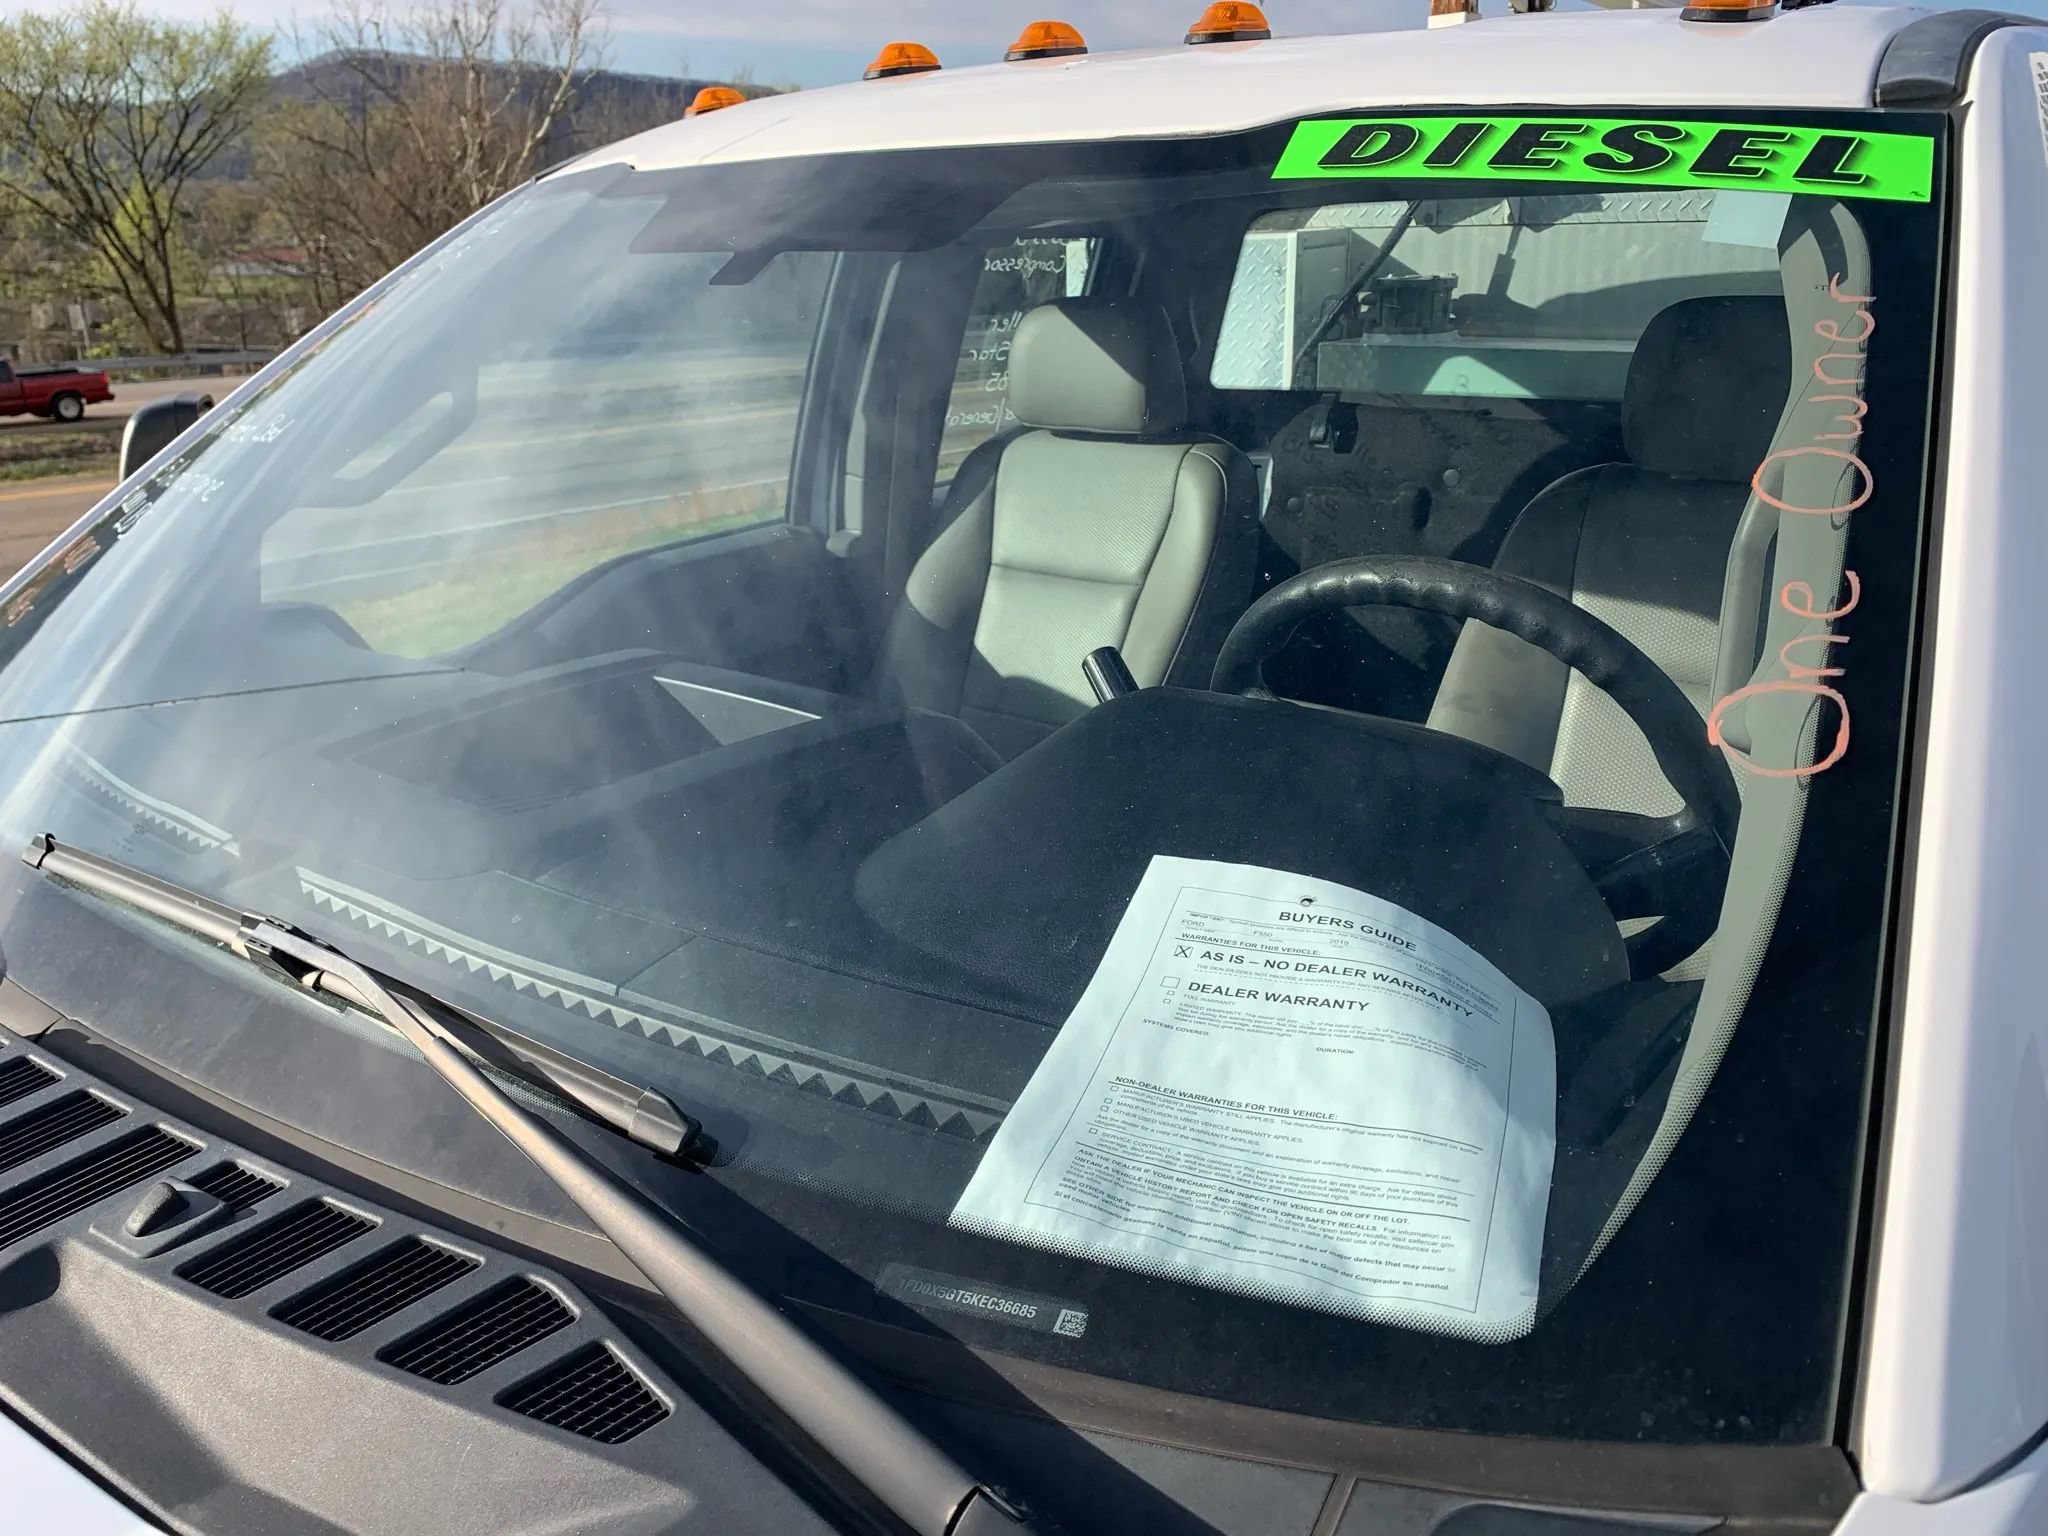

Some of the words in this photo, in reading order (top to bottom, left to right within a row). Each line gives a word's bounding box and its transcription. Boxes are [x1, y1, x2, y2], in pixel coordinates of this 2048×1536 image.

[1317, 122, 1870, 184] DIESEL
[1753, 272, 1876, 514] Owner
[1707, 570, 1861, 777] One
[1181, 919, 1205, 928] FORD
[1181, 932, 1237, 945] WARRANTIES
[1279, 911, 1355, 929] BUYERS
[1360, 924, 1417, 952] GUIDE
[1188, 981, 1260, 1000] DEALER
[1265, 991, 1371, 1011] WARRANTY
[1200, 950, 1224, 962] AS
[1229, 954, 1245, 965] IS
[1264, 959, 1290, 970] NO
[1294, 962, 1367, 979] DEALER
[1373, 972, 1473, 1017] WARRANTY
[1143, 1018, 1174, 1030] SYSTEMS
[1115, 1076, 1176, 1096] NON-DEALER
[1179, 1091, 1241, 1108] WARRANTIES
[1244, 1102, 1265, 1110] FOR
[1268, 1105, 1289, 1114] THIS
[1292, 1109, 1338, 1119] VEHICLE:
[1185, 1103, 1224, 1115] WARRANTY
[1179, 1115, 1198, 1124] USED
[1200, 1120, 1229, 1130] VEHICLE
[1231, 1126, 1270, 1139] WARRANTY
[1189, 1126, 1227, 1140] WARRANTY
[1074, 1156, 1102, 1169] OBTAIN
[1111, 1167, 1142, 1181] VEHICLE
[1144, 1177, 1178, 1191] HISTORY
[1180, 1187, 1212, 1199] REPORT
[1213, 1194, 1230, 1203] AND
[1232, 1199, 1259, 1211] CHECK
[1261, 1207, 1278, 1215] FOR
[1280, 1211, 1302, 1220] OPEN
[1305, 1216, 1336, 1227] SAFETY
[1078, 1149, 1093, 1157] ASK
[1096, 1153, 1109, 1162] THE
[1111, 1157, 1141, 1172] DEALER
[1152, 1170, 1174, 1180] YOUR
[1175, 1175, 1216, 1191] MECHANIC
[1218, 1186, 1234, 1194] CAN
[1236, 1190, 1270, 1202] INSPECT
[1272, 1197, 1287, 1206] THE
[1290, 1201, 1323, 1213] VEHICLE
[1062, 1177, 1076, 1186] SEE
[1078, 1181, 1104, 1196] OTHER
[1106, 1191, 1124, 1202] SIDE
[1125, 1197, 1135, 1206] for
[1353, 1255, 1382, 1265] defects
[1402, 1262, 1419, 1271] may
[1421, 1264, 1445, 1272] occur
